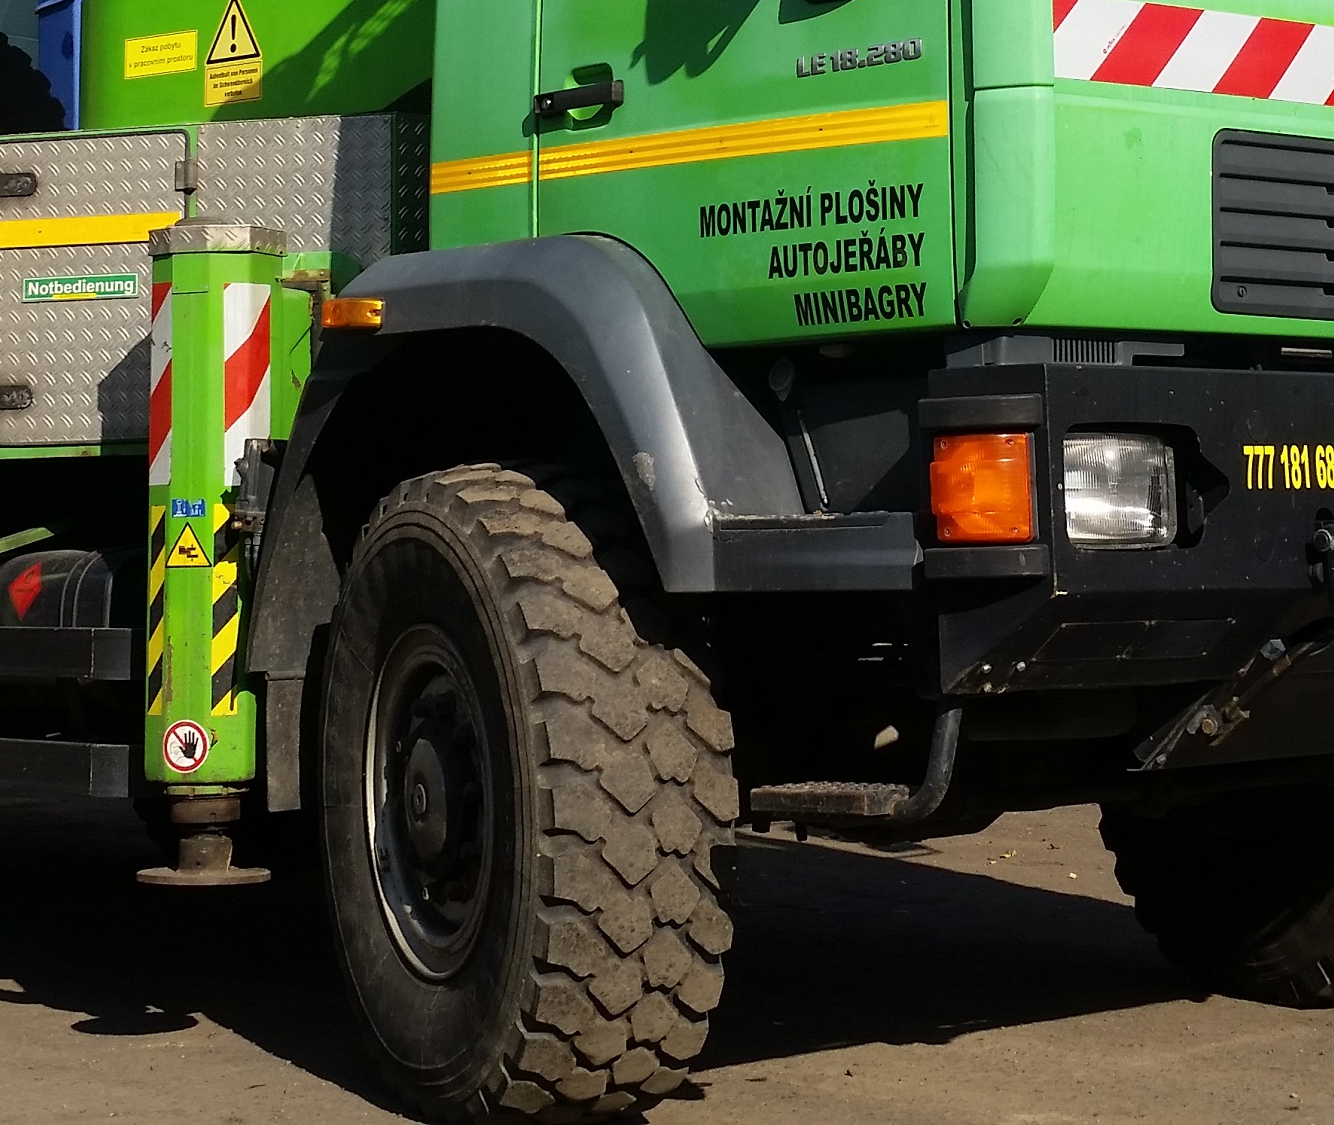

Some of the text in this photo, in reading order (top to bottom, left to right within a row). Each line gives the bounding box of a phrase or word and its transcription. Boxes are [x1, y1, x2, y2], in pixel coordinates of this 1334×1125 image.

[796, 38, 923, 77] LE 18.280
[700, 180, 924, 238] MONTAŽNÍ PLOŠINY
[768, 228, 925, 279] AUTOJEŘÁBY
[27, 277, 134, 296] Notbedienung
[794, 282, 927, 326] MINIBAGRY
[1243, 445, 1275, 490] 777
[1280, 444, 1311, 489] 181
